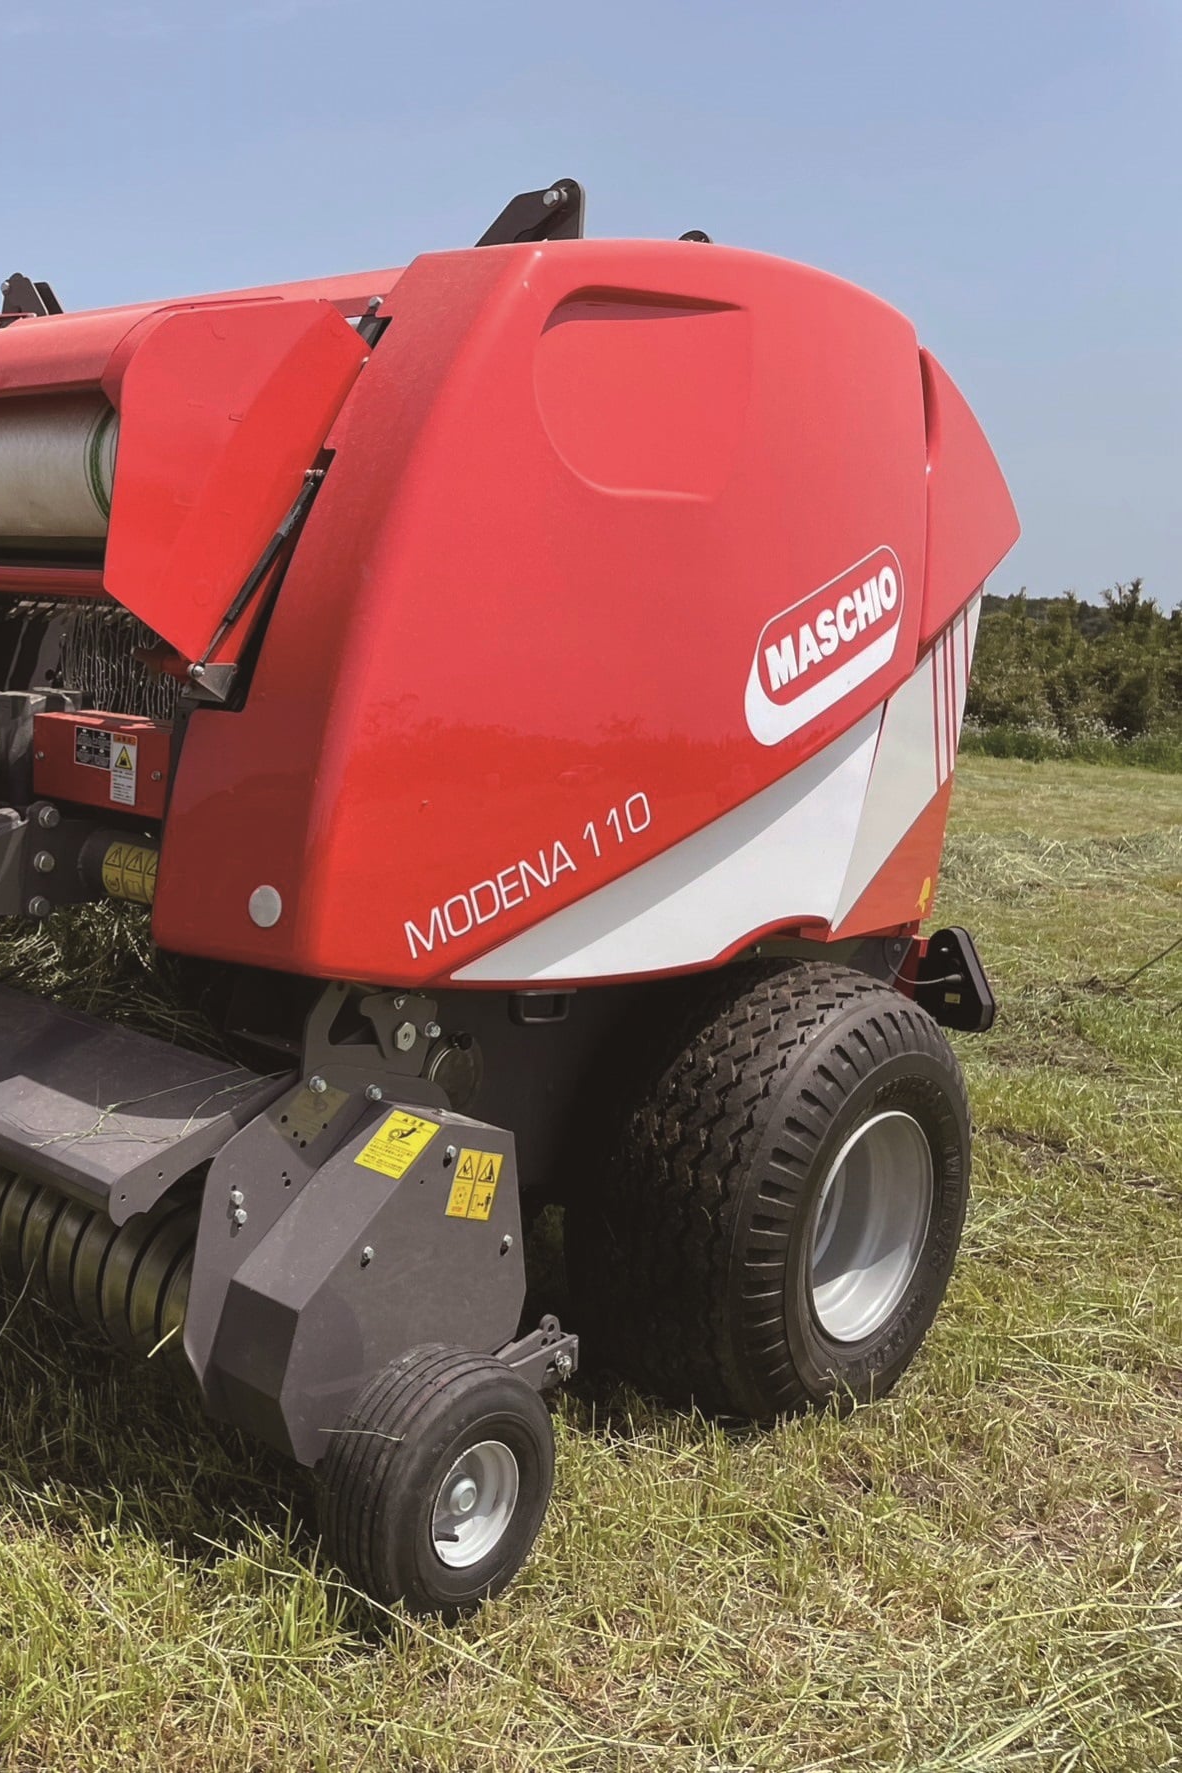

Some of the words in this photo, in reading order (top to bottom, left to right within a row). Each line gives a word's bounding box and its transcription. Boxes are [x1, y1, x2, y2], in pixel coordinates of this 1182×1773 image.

[764, 566, 898, 692] MASCHIO
[404, 840, 577, 959] MODENA
[583, 792, 651, 857] 110
